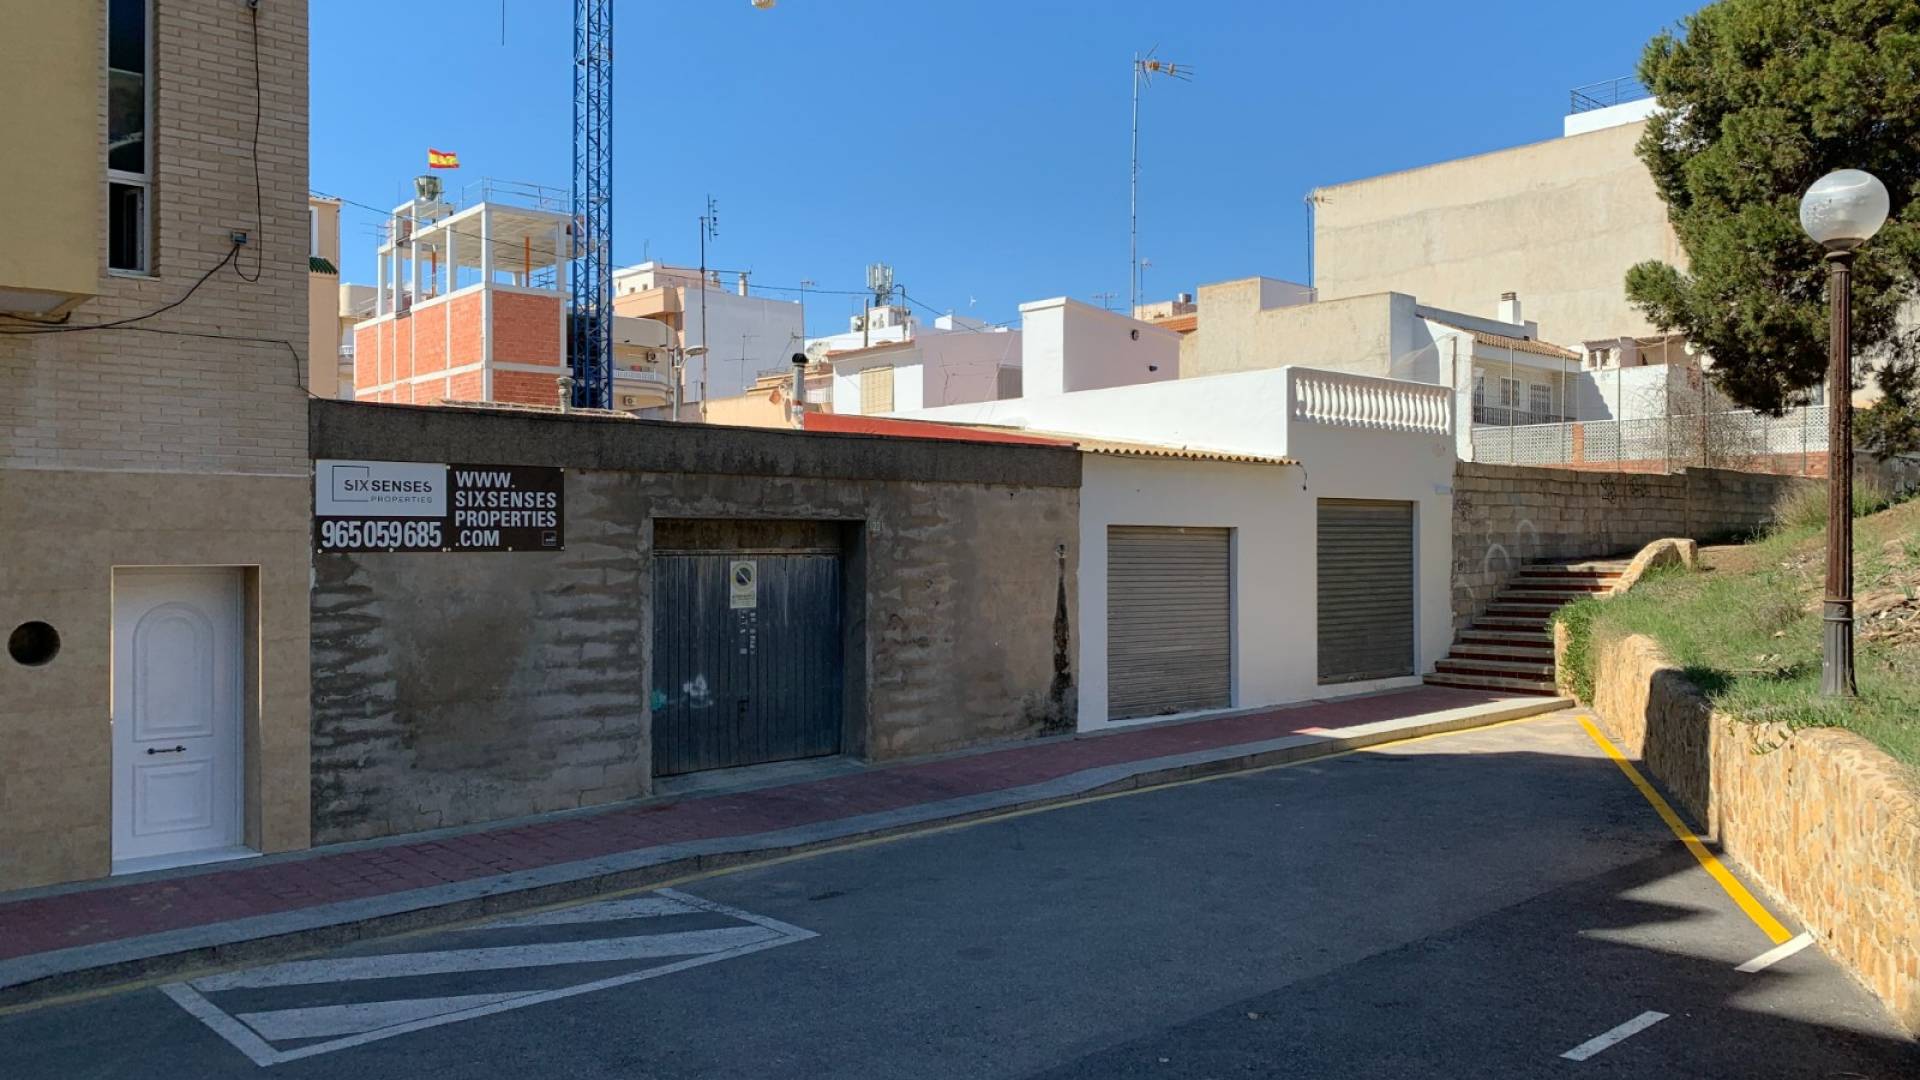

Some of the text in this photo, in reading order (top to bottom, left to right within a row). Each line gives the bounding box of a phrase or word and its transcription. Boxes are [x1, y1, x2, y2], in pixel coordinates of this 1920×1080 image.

[455, 471, 516, 488] WWW.
[371, 495, 433, 504] PROPERTIES
[455, 491, 557, 508] SIXSENSES
[455, 511, 557, 527] PROPERTIES
[455, 530, 500, 547] .COM
